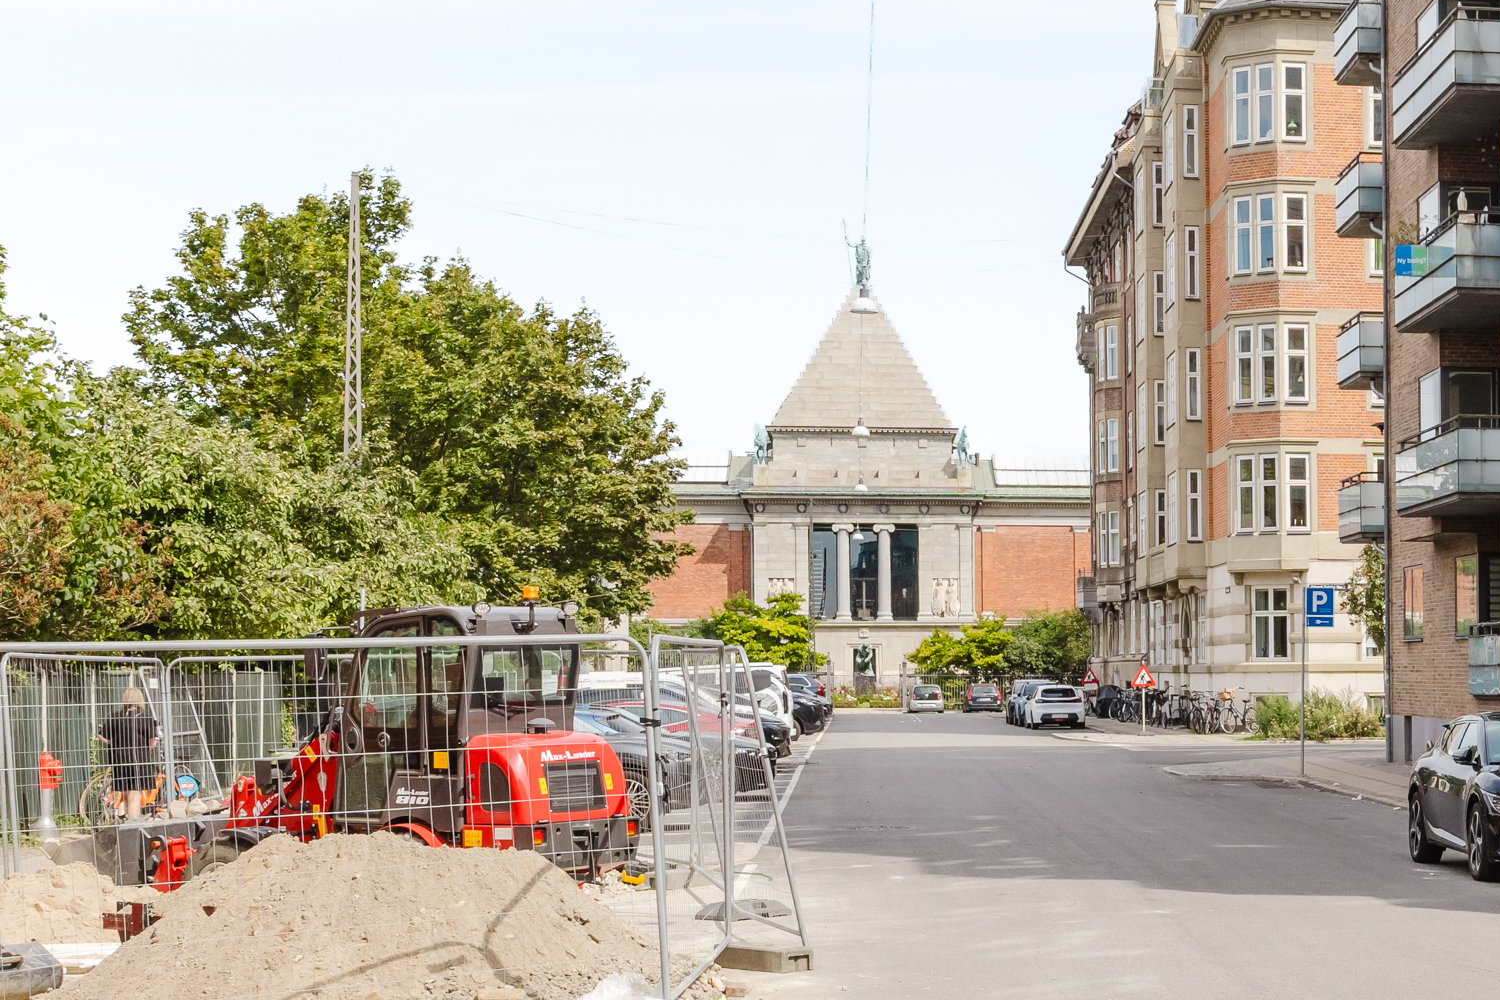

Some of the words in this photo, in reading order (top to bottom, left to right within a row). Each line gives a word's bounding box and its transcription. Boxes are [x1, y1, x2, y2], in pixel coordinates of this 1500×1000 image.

[1312, 591, 1328, 612] P
[541, 750, 596, 761] Max-Loader
[395, 796, 429, 805] 810
